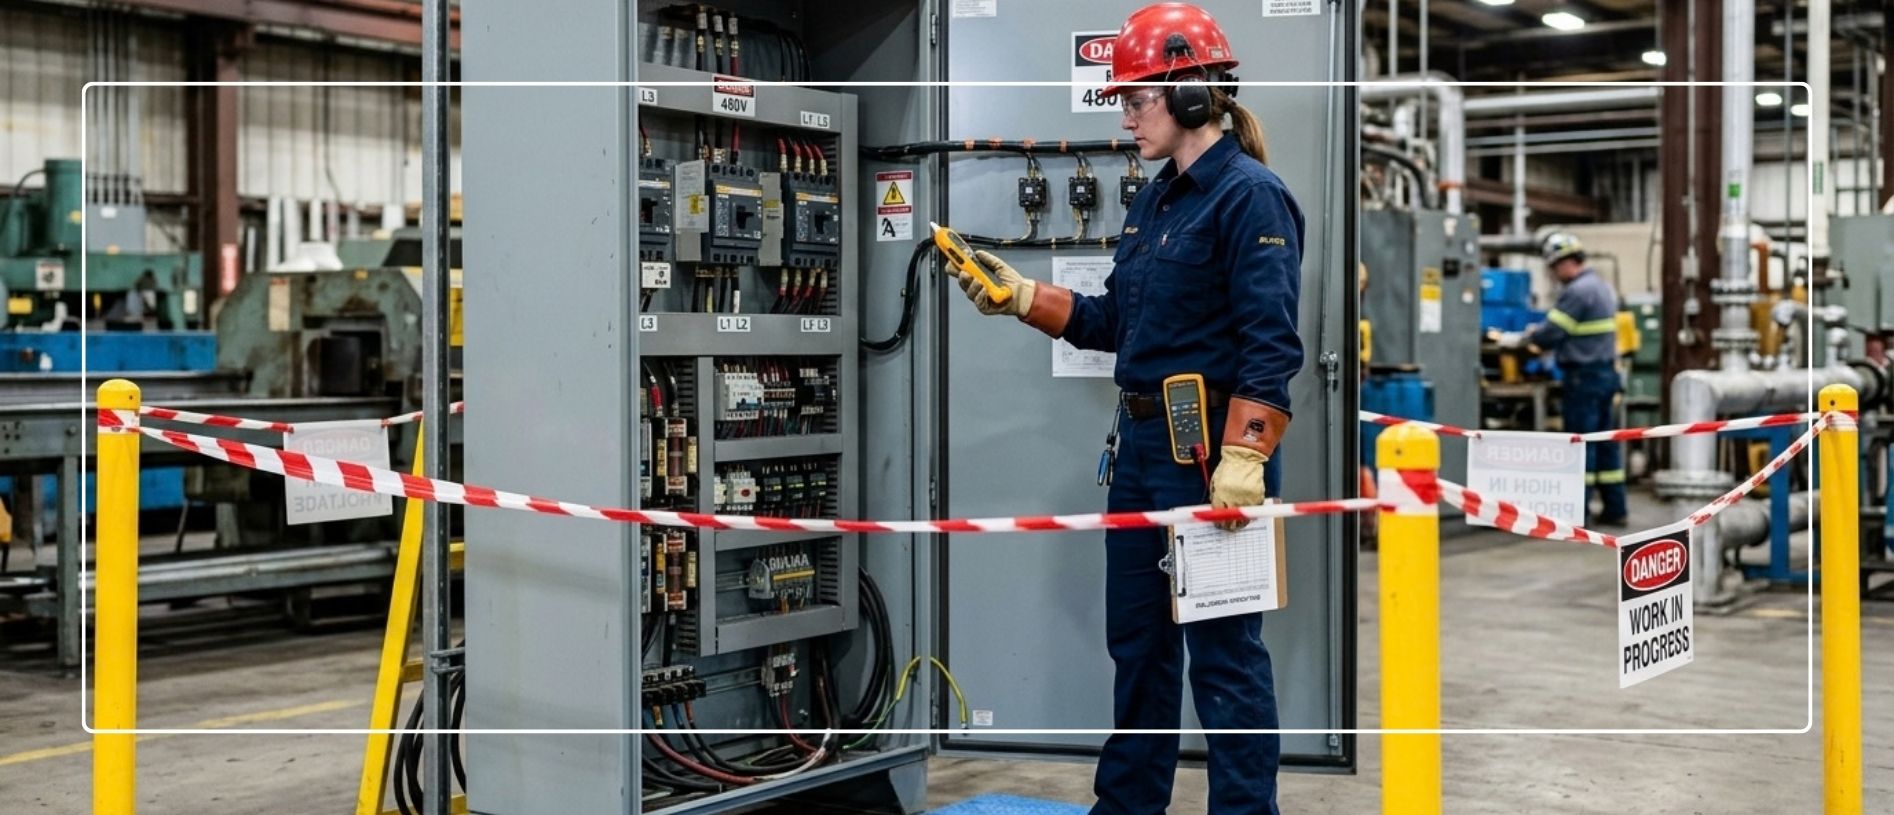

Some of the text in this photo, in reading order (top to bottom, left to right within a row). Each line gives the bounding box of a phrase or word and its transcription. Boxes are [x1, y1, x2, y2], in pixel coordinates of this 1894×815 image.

[641, 90, 655, 102] L3
[1082, 88, 1122, 107] 480
[720, 318, 748, 330] L1 L2
[1630, 547, 1682, 583] DANGER
[1629, 593, 1683, 635] WORK IN
[1624, 626, 1690, 674] PROGRESS
